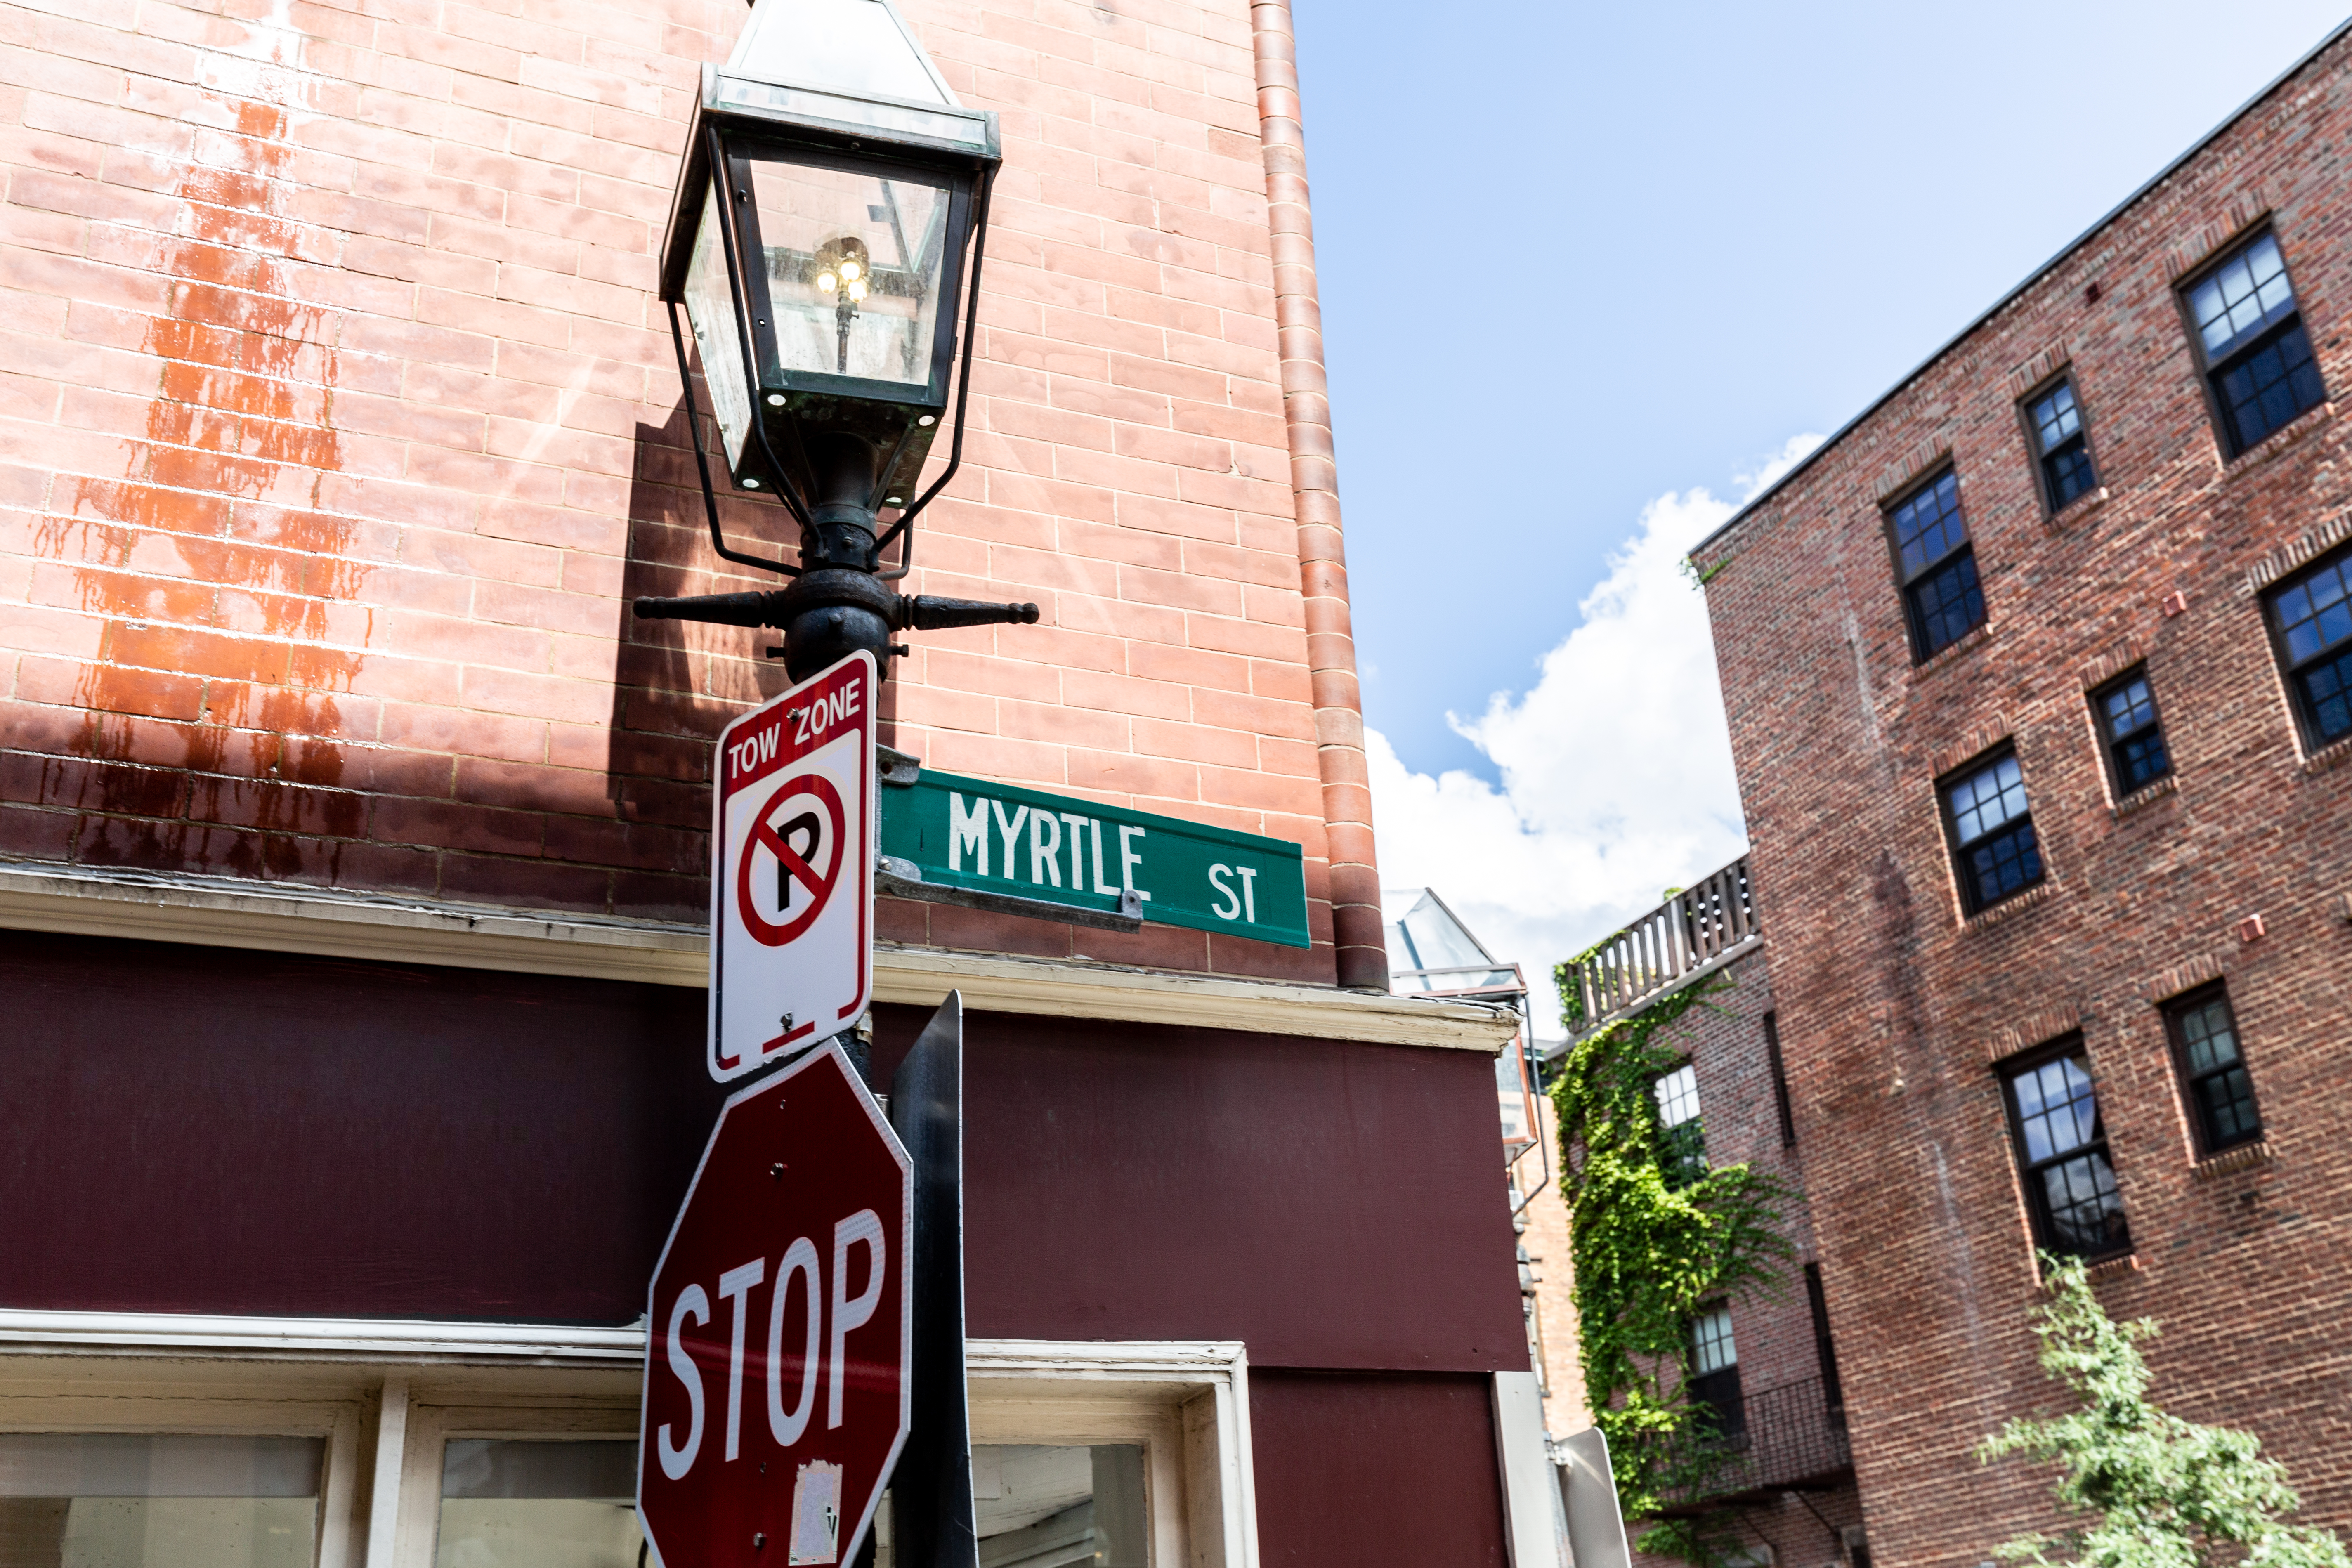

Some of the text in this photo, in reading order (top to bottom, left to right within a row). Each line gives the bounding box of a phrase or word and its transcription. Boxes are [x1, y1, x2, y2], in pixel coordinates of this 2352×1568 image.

[729, 678, 860, 779] TOW ZONE
[777, 812, 821, 913] P
[948, 792, 1257, 923] MYRTLE ST
[658, 1209, 886, 1481] STOP
